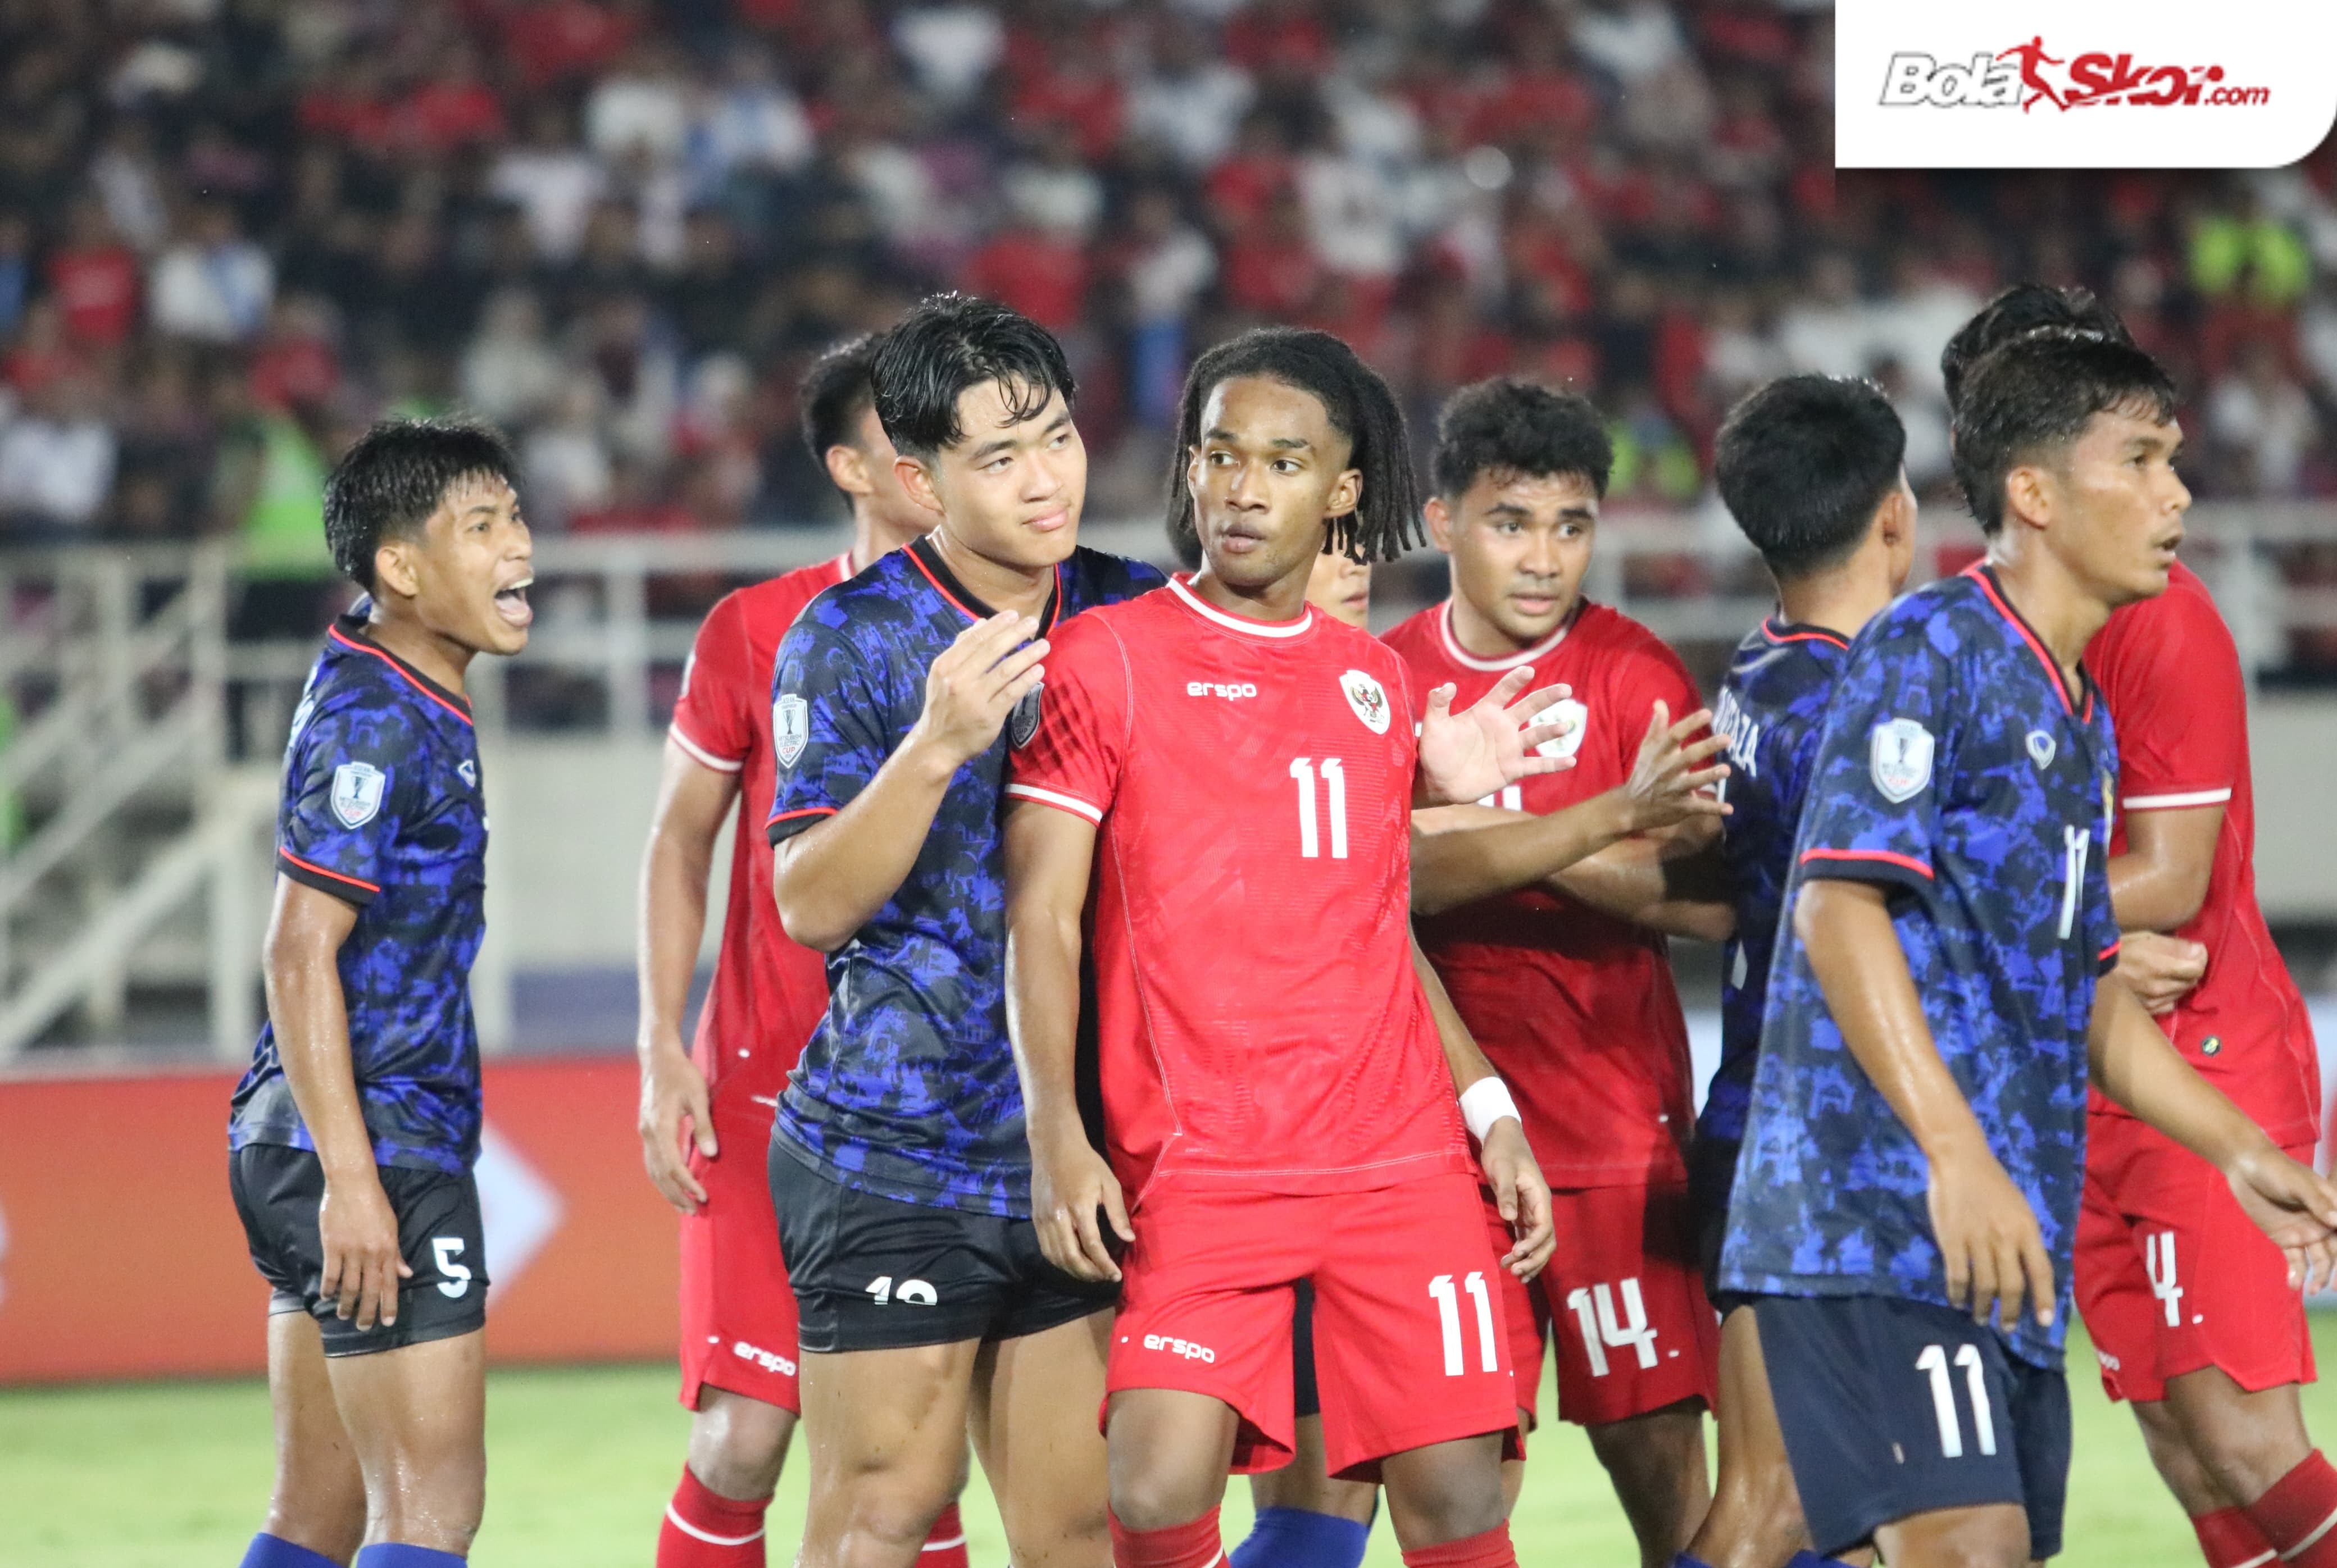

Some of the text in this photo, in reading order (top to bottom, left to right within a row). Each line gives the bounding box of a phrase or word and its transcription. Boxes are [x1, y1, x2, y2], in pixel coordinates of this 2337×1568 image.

[1186, 681, 1257, 701] erspo
[1290, 758, 1348, 859] 11
[432, 1238, 472, 1298] 5
[2146, 1231, 2184, 1327] 4
[734, 1341, 797, 1376] erspo
[1143, 1333, 1215, 1363] erspo
[1428, 1271, 1498, 1376] 11
[1567, 1277, 1658, 1378] 14
[1915, 1344, 1997, 1458] 11
